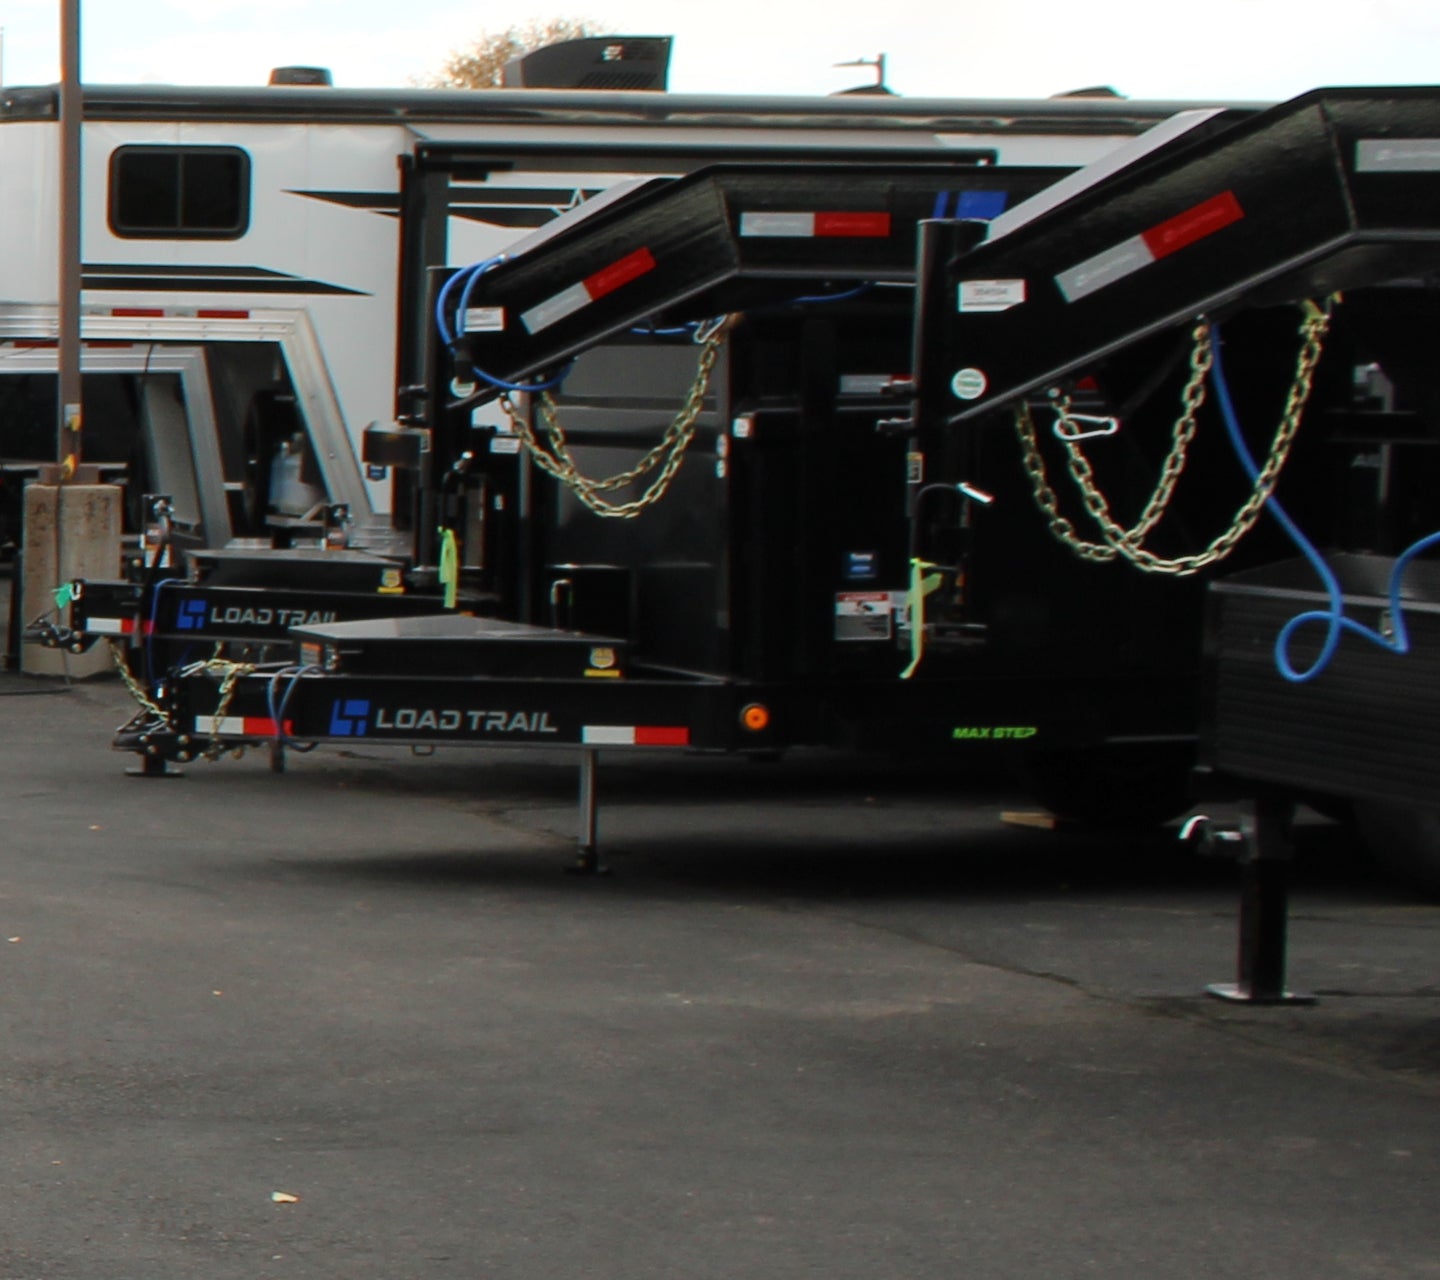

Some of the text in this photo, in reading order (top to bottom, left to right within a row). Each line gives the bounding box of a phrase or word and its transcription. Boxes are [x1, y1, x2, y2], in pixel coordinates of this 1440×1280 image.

[210, 606, 273, 625] LOAD
[375, 708, 558, 733] LOAD TRAIL
[952, 726, 1039, 739] MAX STEP
